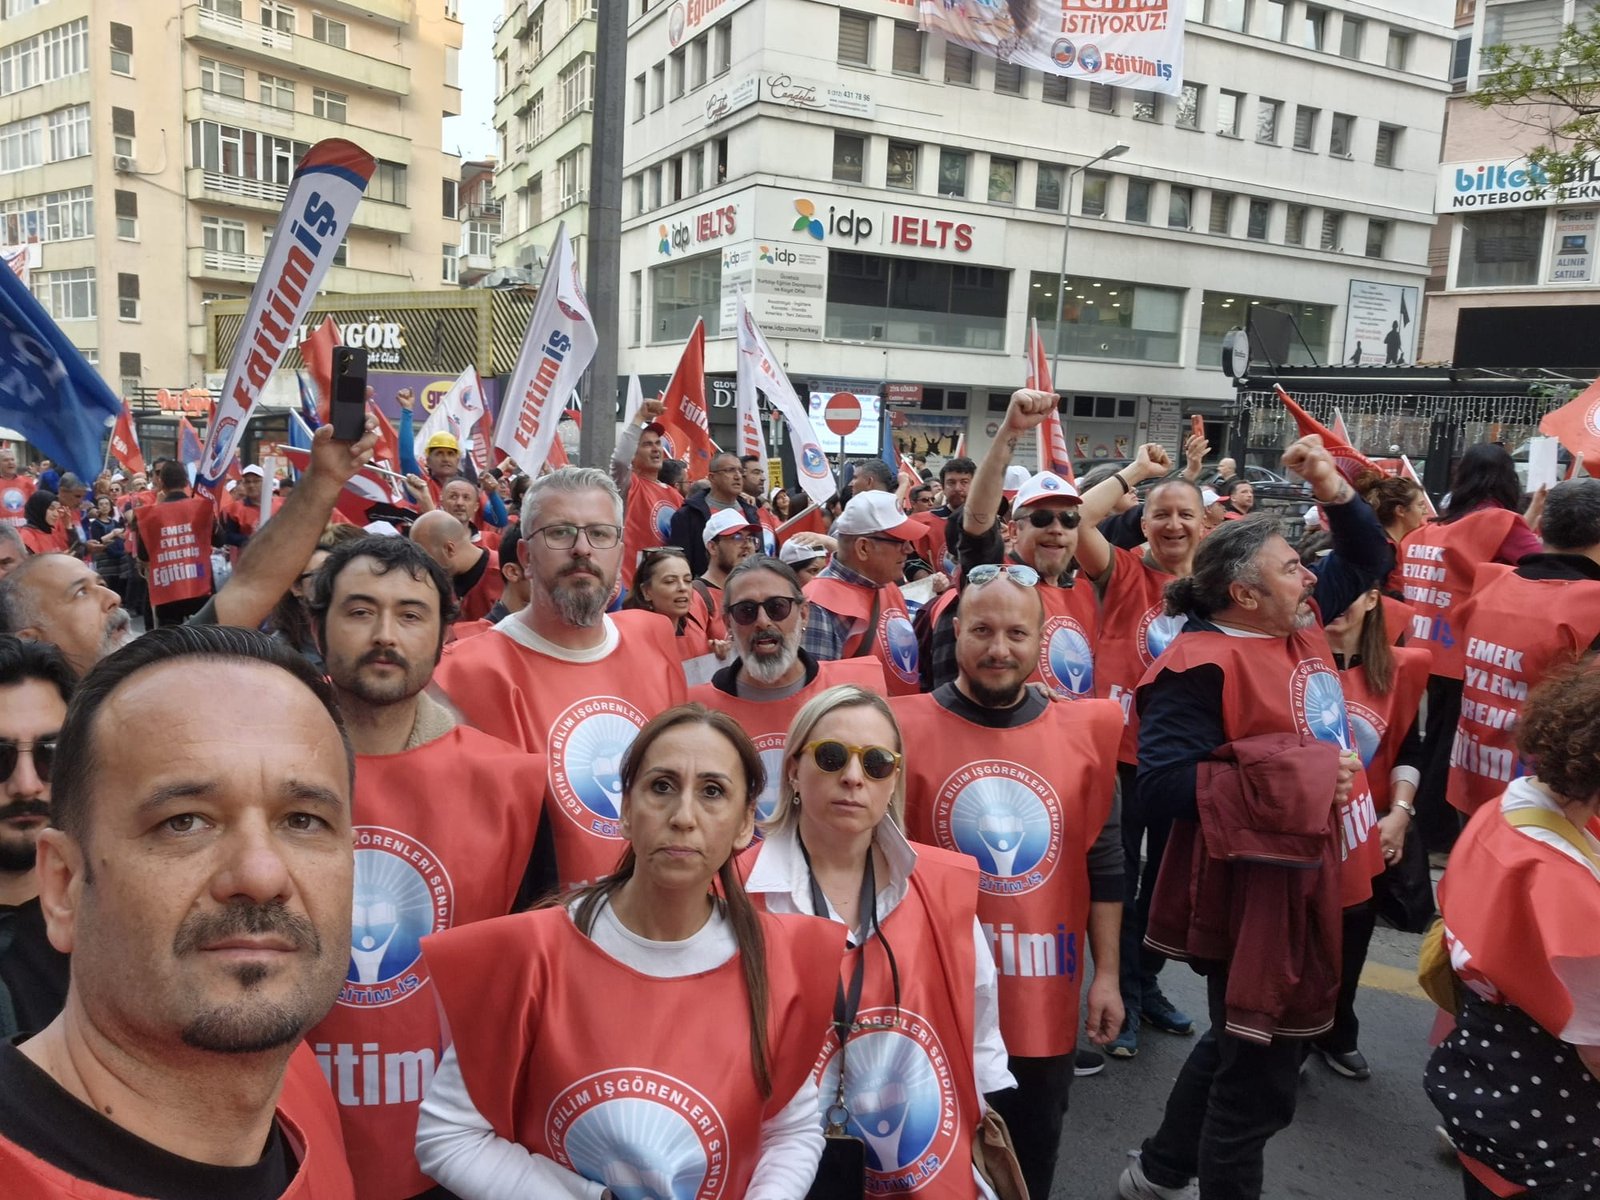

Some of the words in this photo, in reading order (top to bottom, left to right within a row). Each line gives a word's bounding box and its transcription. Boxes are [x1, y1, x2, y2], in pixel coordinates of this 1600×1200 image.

[1061, 12, 1168, 34] İSTİYORUZ!
[1104, 52, 1172, 81] Eğitimiş
[843, 90, 853, 99] 431
[1453, 189, 1546, 207] NOTEBOOK
[671, 221, 690, 252] idp
[696, 205, 735, 242] IELTS
[829, 206, 873, 244] idp
[891, 215, 973, 251] IELTS
[775, 247, 796, 266] idp
[1557, 258, 1586, 266] ALINIR
[1554, 270, 1585, 279] SATILIR
[514, 329, 571, 449] Eğitimiş
[161, 523, 192, 536] EMEK
[1407, 544, 1446, 562] EMEK
[1403, 562, 1446, 582] EYLEM
[1403, 582, 1452, 608] İRENİŞ
[1412, 614, 1456, 648] miş
[1466, 637, 1524, 672] EMEK
[1465, 665, 1528, 701] YLEM
[553, 717, 576, 750] BİLİM
[553, 753, 561, 768] VE
[555, 772, 583, 815] EĞİTİM
[944, 772, 971, 800] BİLİM
[972, 764, 1049, 797] İŞGÖRENLERİ
[940, 801, 949, 816] VE
[1046, 798, 1060, 863] SENDİKASI
[358, 832, 436, 874] ÖRENLERİ
[594, 1075, 718, 1136] İŞGÖRENLERİ
[929, 1046, 954, 1137] SENDİKASI
[553, 1090, 591, 1129] BİLİM
[551, 1129, 561, 1148] VE
